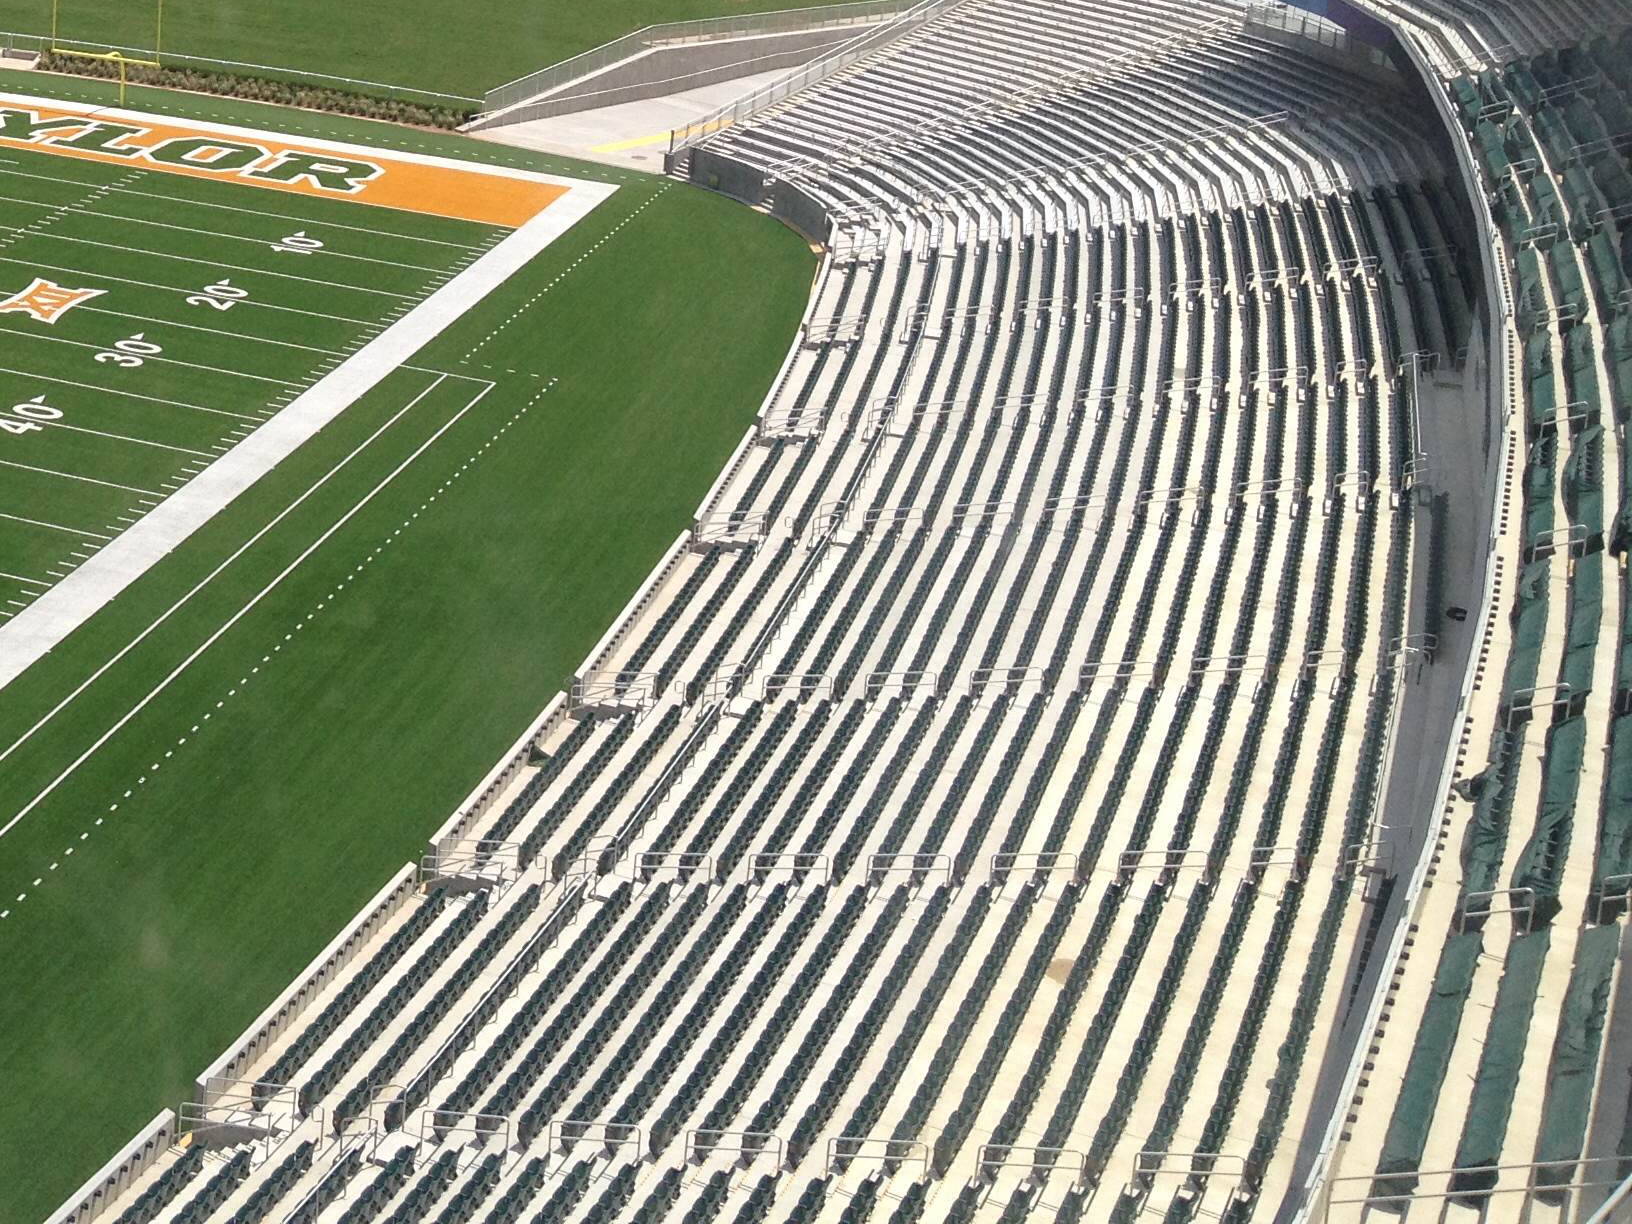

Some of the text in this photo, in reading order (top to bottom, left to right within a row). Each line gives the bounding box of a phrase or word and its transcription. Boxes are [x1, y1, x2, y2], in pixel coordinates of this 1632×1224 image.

[270, 236, 324, 255] 10
[186, 284, 249, 311] 20
[94, 338, 163, 368] 30
